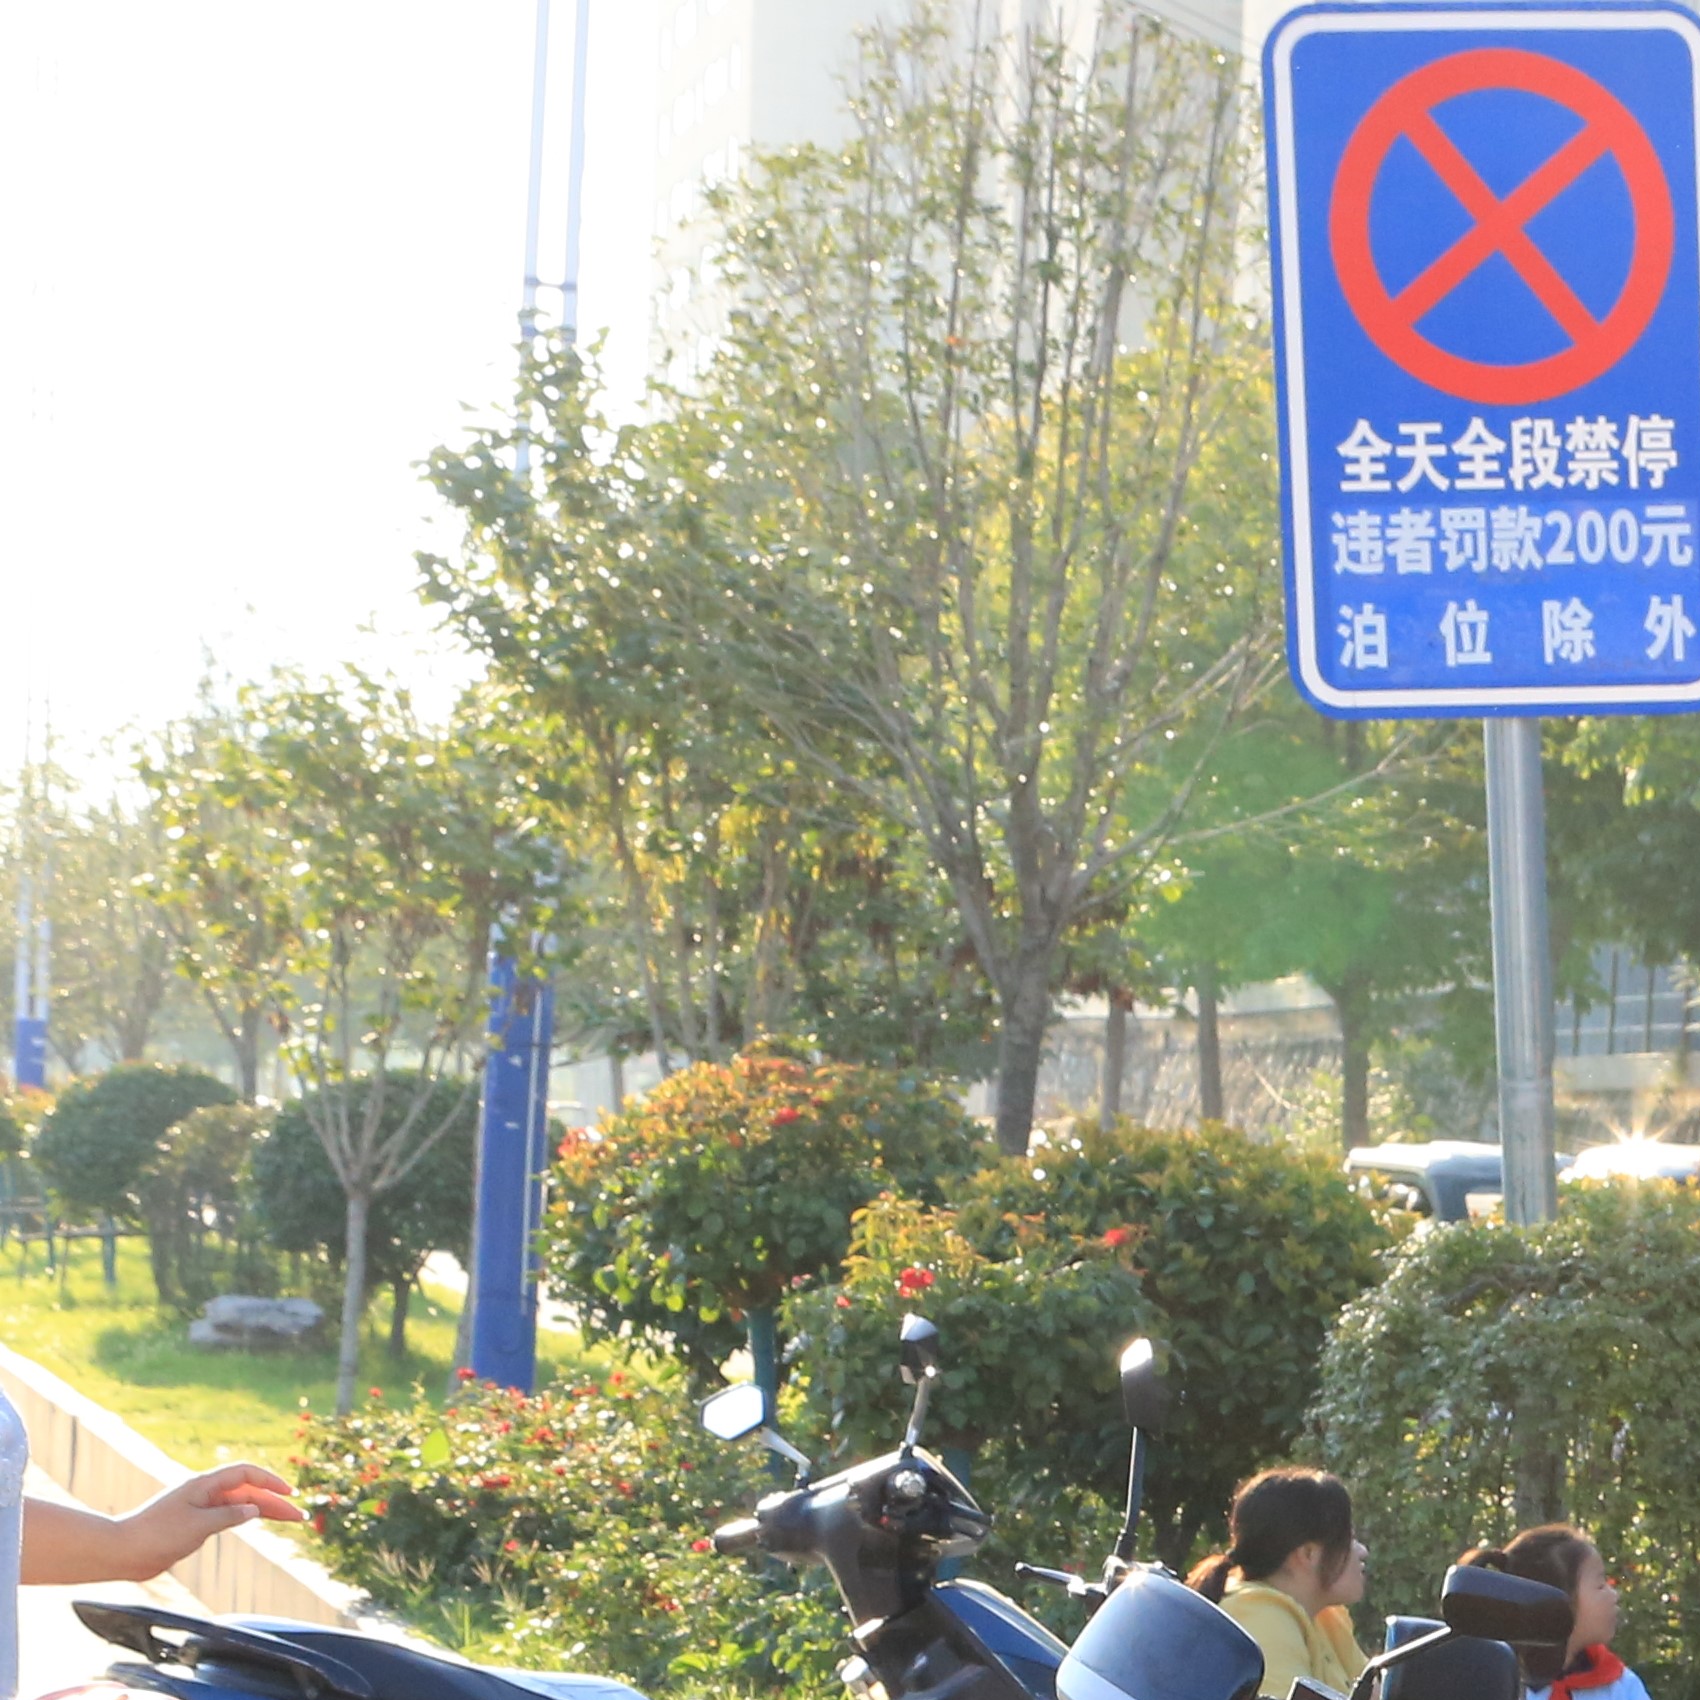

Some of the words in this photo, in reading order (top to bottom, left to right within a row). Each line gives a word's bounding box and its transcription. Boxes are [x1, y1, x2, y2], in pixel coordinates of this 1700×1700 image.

[1335, 414, 1679, 494] 全天全段禁停
[1330, 504, 1693, 577] 违者罚款200元
[1337, 595, 1697, 671] 泊位除外
